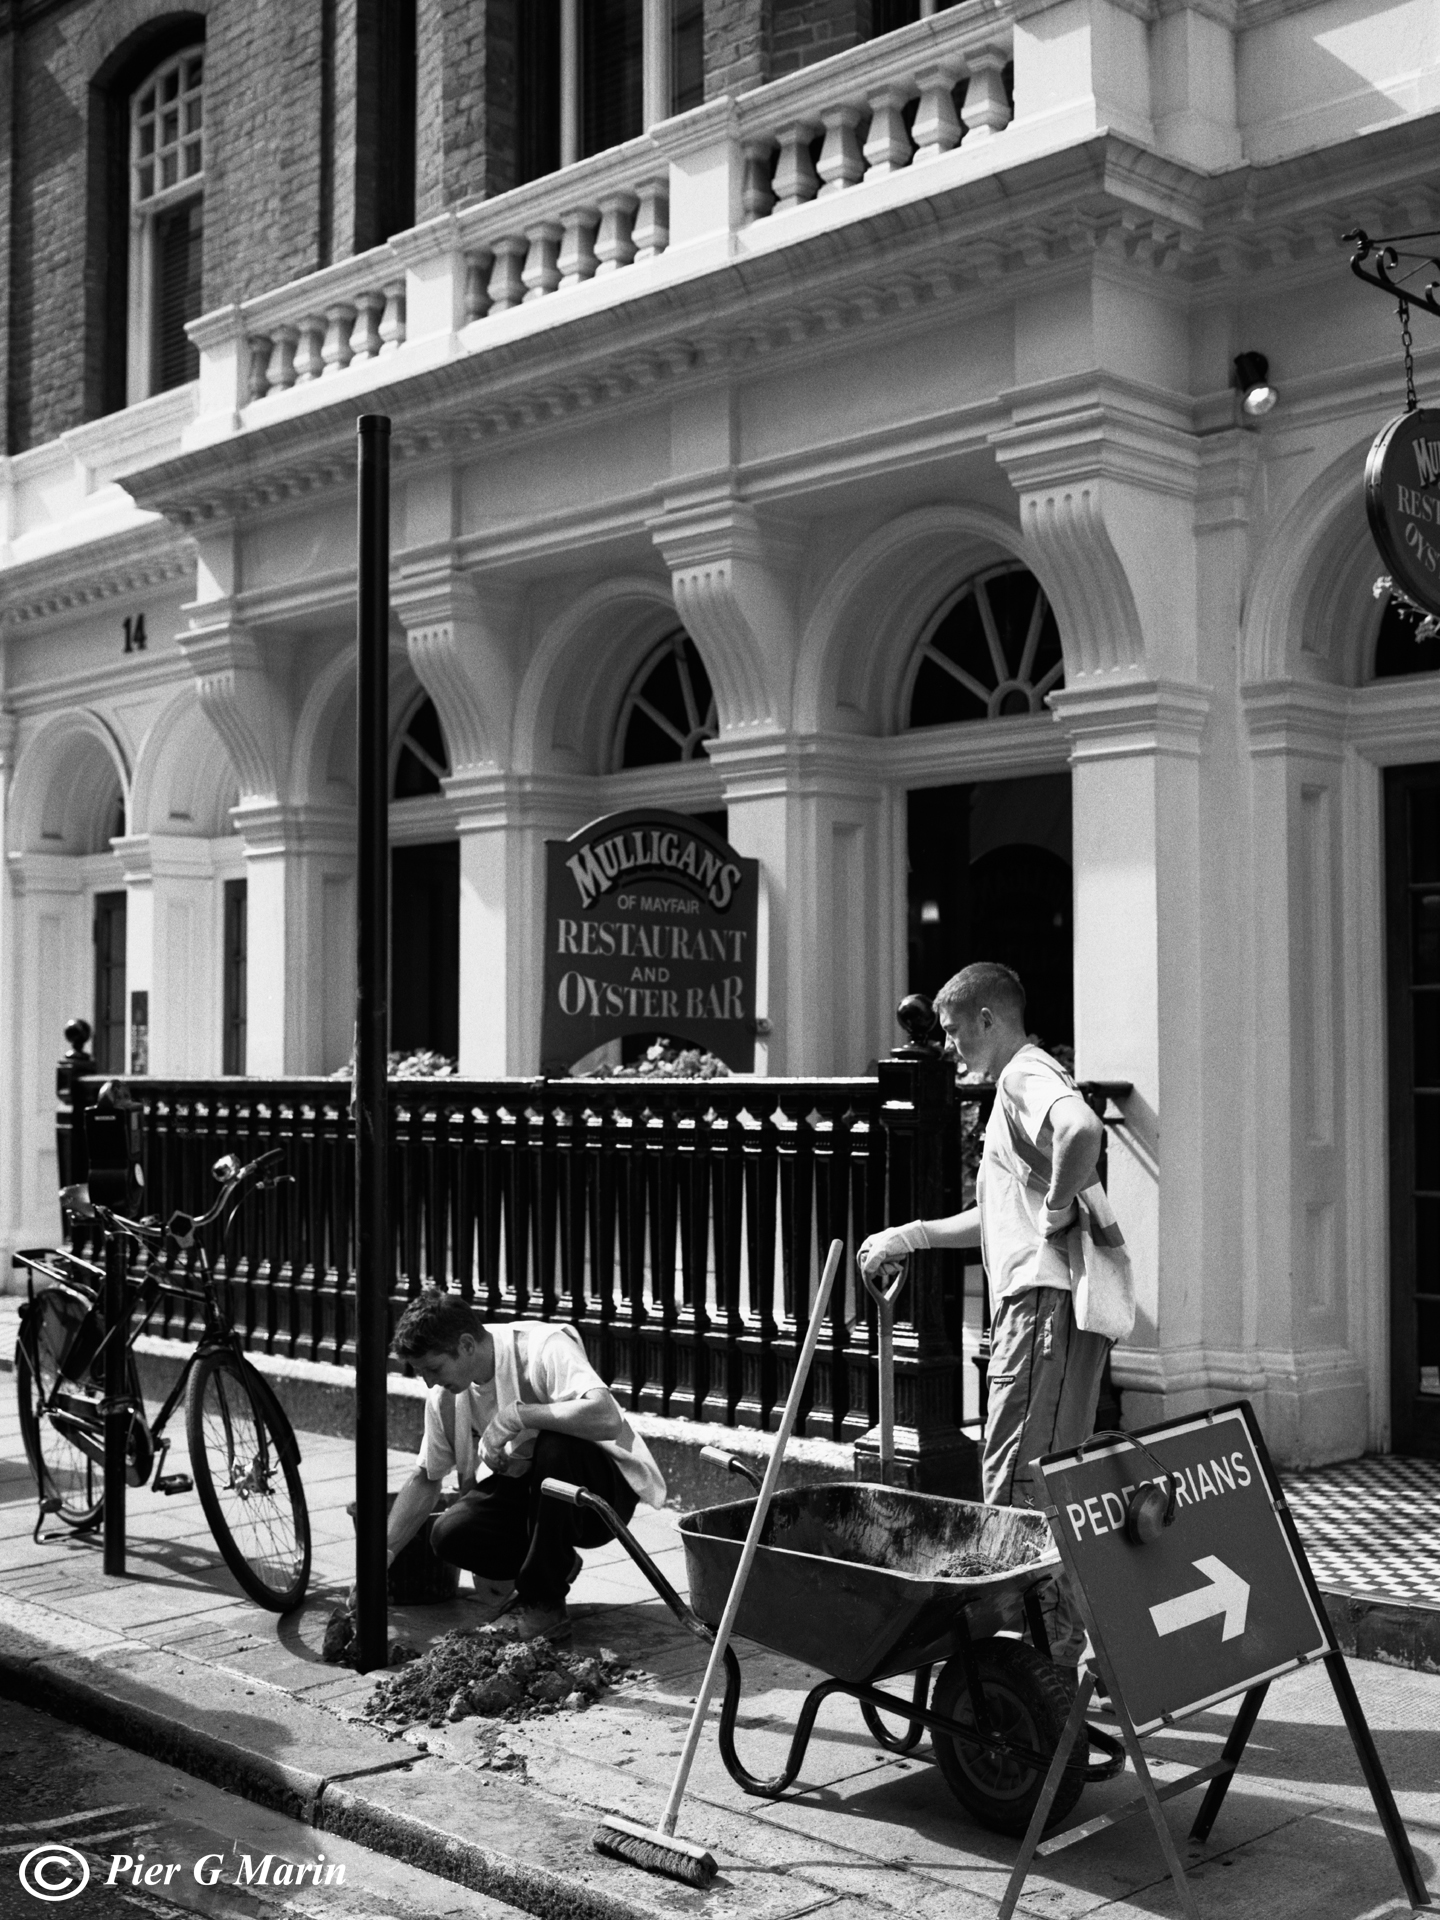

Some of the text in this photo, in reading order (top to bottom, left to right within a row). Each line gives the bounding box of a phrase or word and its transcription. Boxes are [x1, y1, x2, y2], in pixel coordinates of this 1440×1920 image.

[123, 613, 147, 653] 14
[565, 831, 742, 909] MULLIGANS
[617, 895, 700, 914] OF MAYFAIR
[557, 918, 747, 962] RESTAURANT
[558, 971, 746, 1019] OYSTER BAR
[630, 966, 670, 983] AND
[1065, 1451, 1252, 1542] PEDTRIANS
